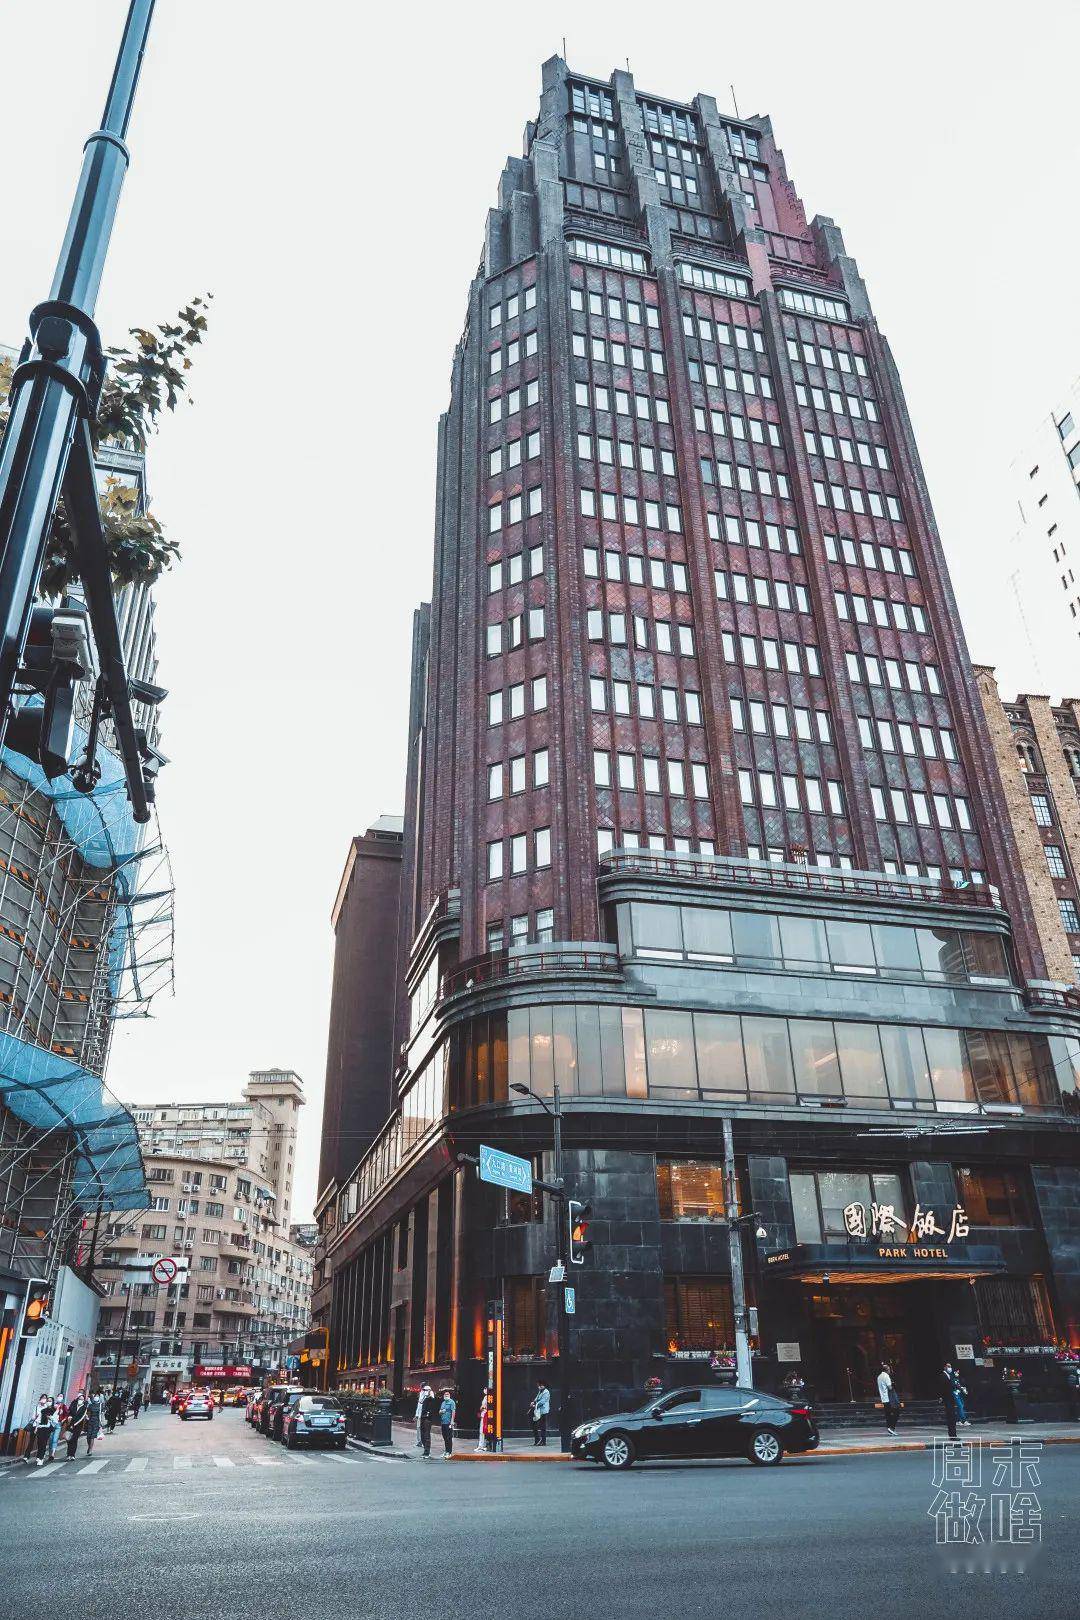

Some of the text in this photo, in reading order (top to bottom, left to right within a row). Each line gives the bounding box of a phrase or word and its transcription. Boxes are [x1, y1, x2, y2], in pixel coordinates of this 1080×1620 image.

[843, 1201, 970, 1244] 國際飯店
[879, 1248, 949, 1258] PARK HOTEL
